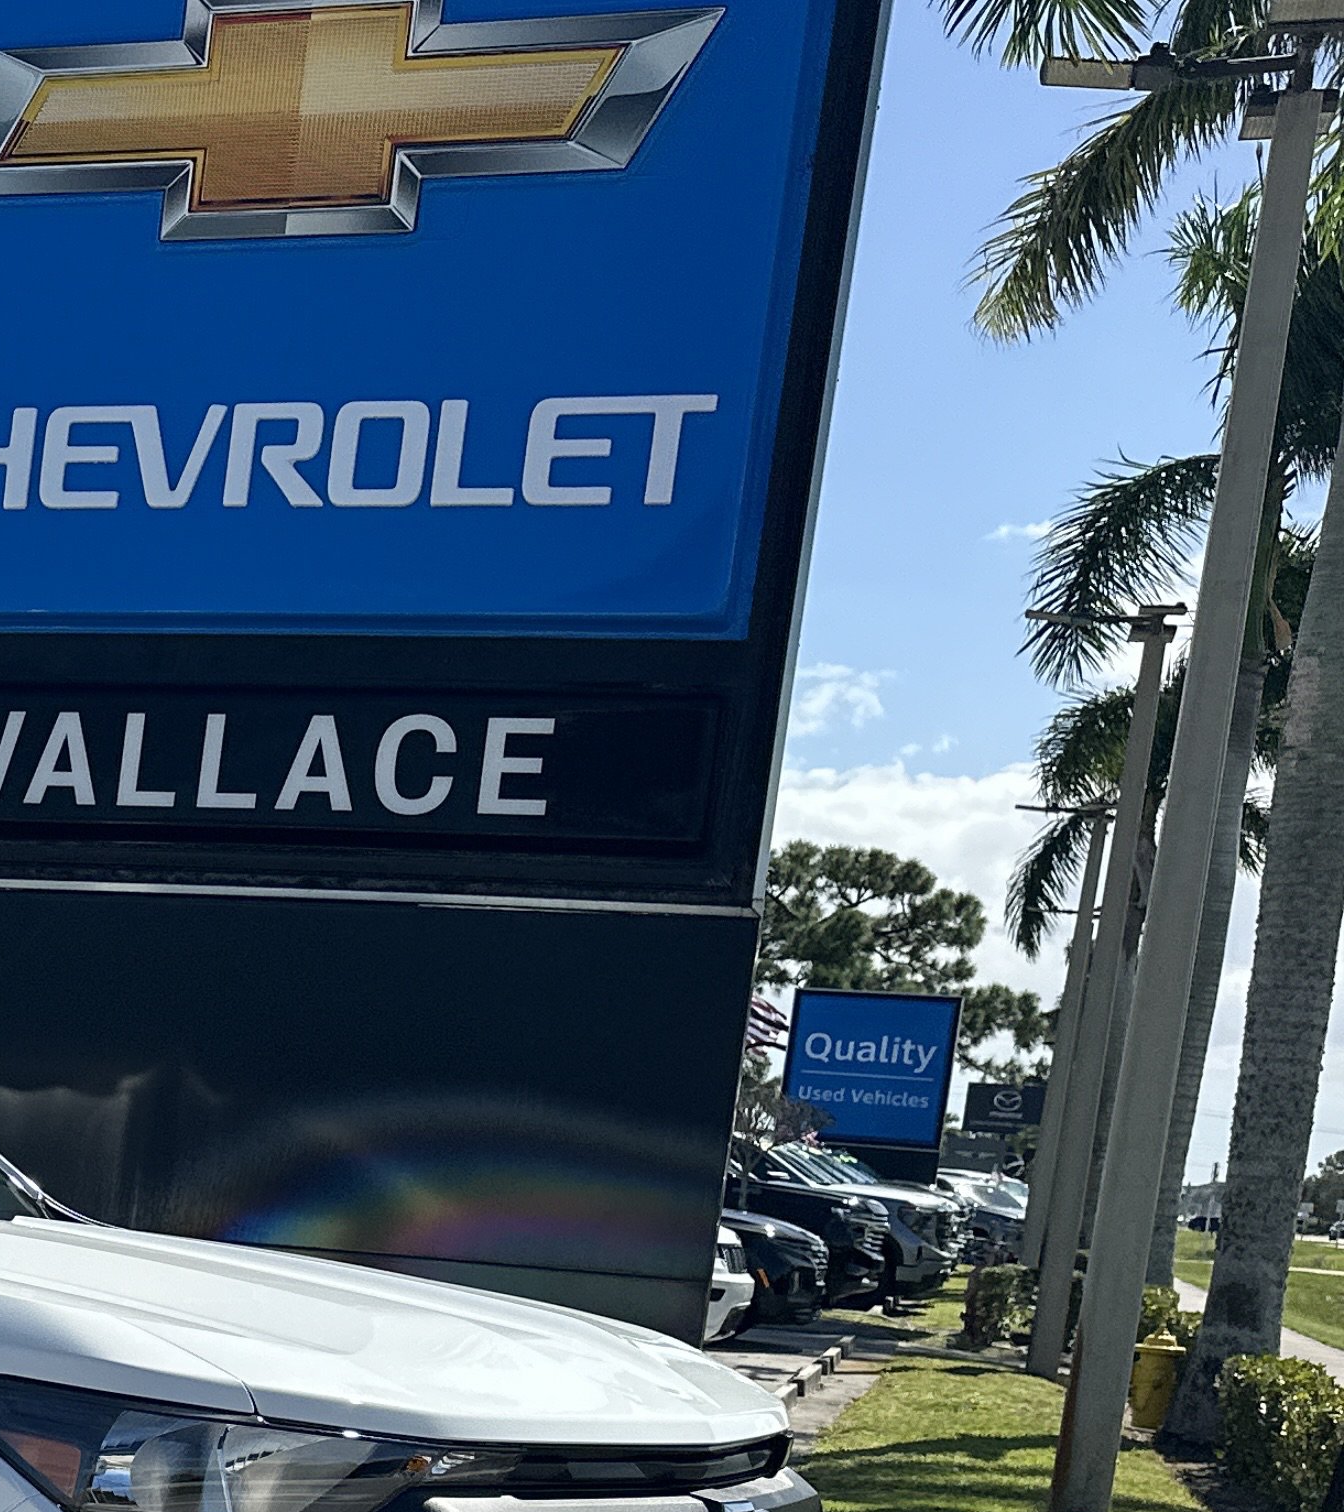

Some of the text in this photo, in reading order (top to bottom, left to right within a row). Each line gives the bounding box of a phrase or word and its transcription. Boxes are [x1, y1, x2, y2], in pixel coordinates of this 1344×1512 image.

[804, 1032, 938, 1074] Quality
[798, 1085, 930, 1109] Used Vehicles
